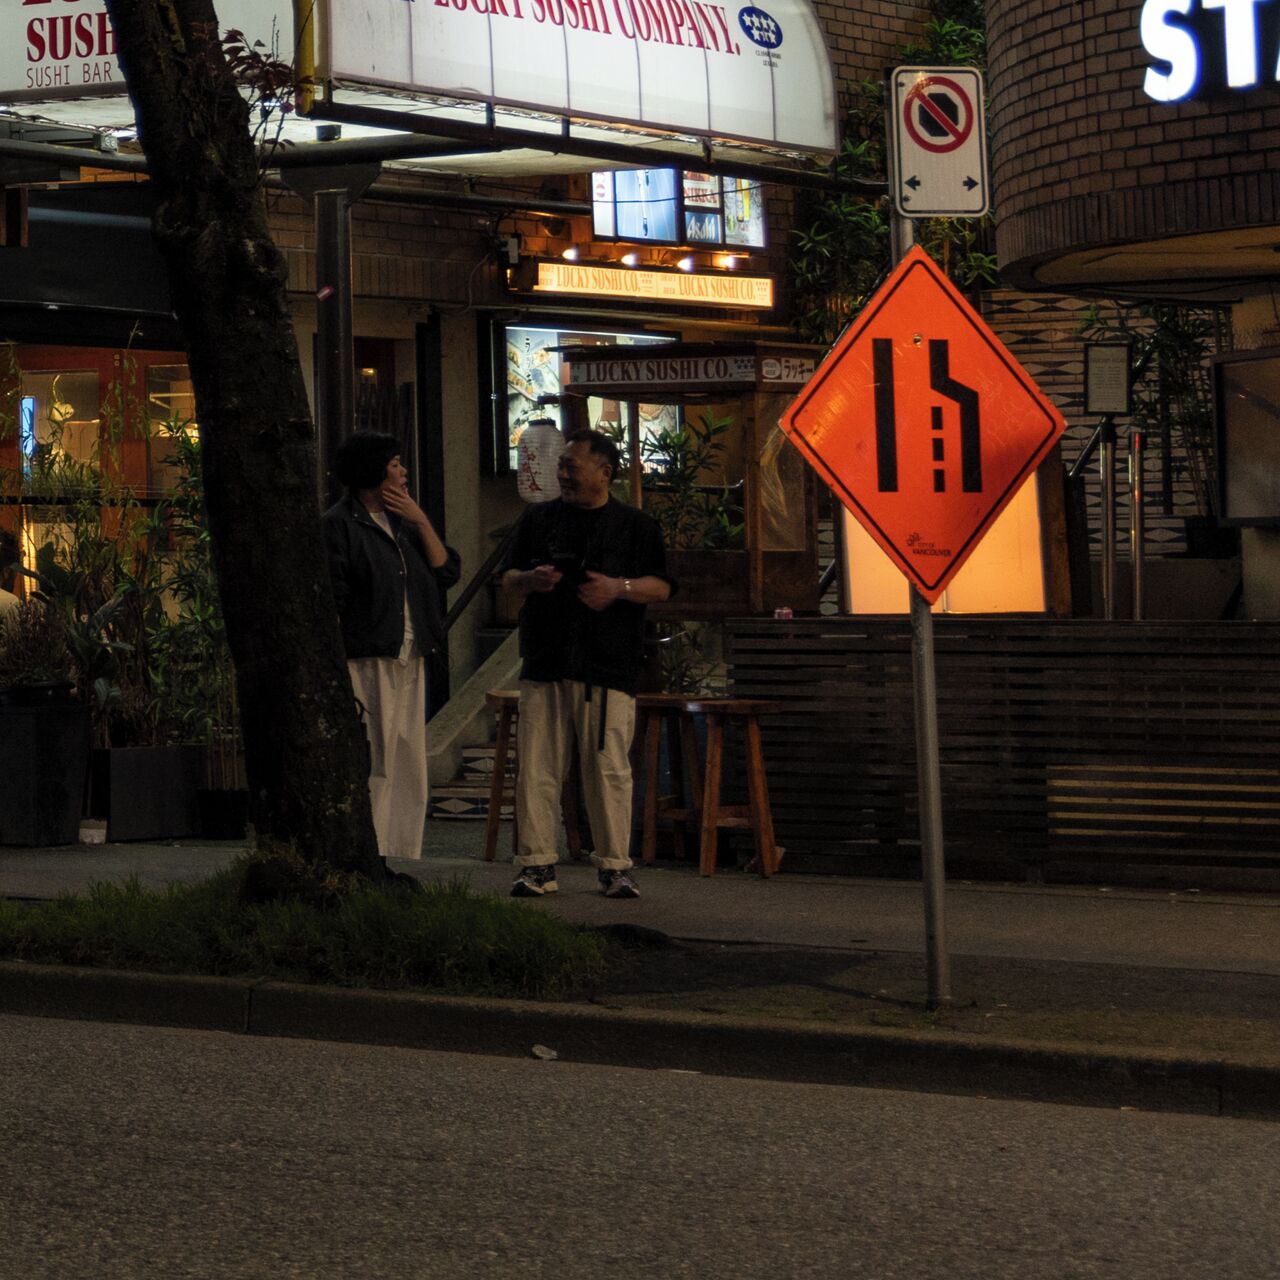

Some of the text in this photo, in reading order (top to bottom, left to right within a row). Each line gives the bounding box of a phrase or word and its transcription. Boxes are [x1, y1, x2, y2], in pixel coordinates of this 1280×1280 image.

[25, 10, 118, 63] SUSH
[26, 60, 114, 89] SUSHI BAR
[556, 265, 590, 290] LUCKY
[591, 267, 623, 292] SUSHI
[677, 274, 710, 297] LUCKY
[710, 276, 740, 300] SUSHI
[586, 357, 733, 382] LUCKY SUSHI CO.
